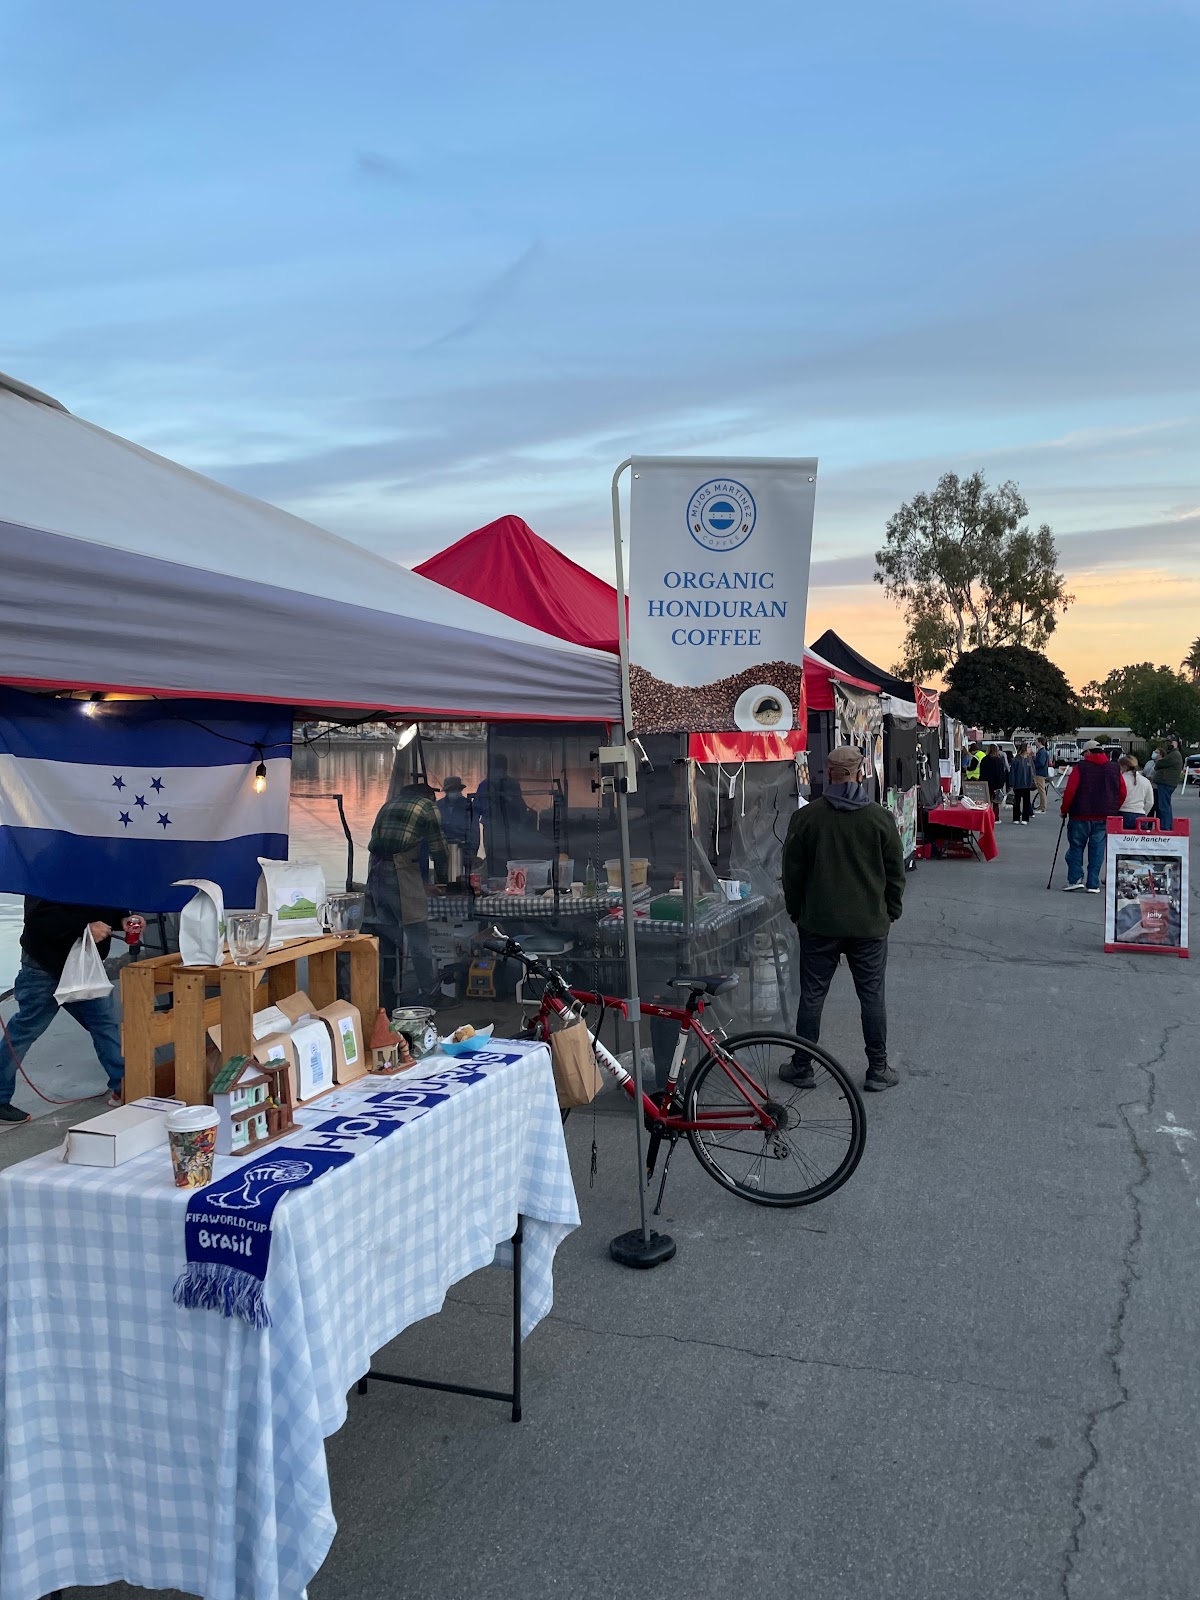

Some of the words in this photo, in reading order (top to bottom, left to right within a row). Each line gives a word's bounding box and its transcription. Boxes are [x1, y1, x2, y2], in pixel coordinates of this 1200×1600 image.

[691, 488, 711, 518] MIJOS
[714, 484, 752, 518] MARTINEZ
[702, 535, 740, 546] COFFEE
[663, 571, 774, 589] ORGANIC
[647, 600, 788, 618] HONDURAN
[671, 629, 761, 646] COFFEE
[1122, 835, 1139, 843] Jolly
[302, 1051, 507, 1150] HONDURAS
[185, 1212, 209, 1223] FIFA
[246, 1220, 268, 1233] CUP
[198, 1229, 253, 1257] Brasil
